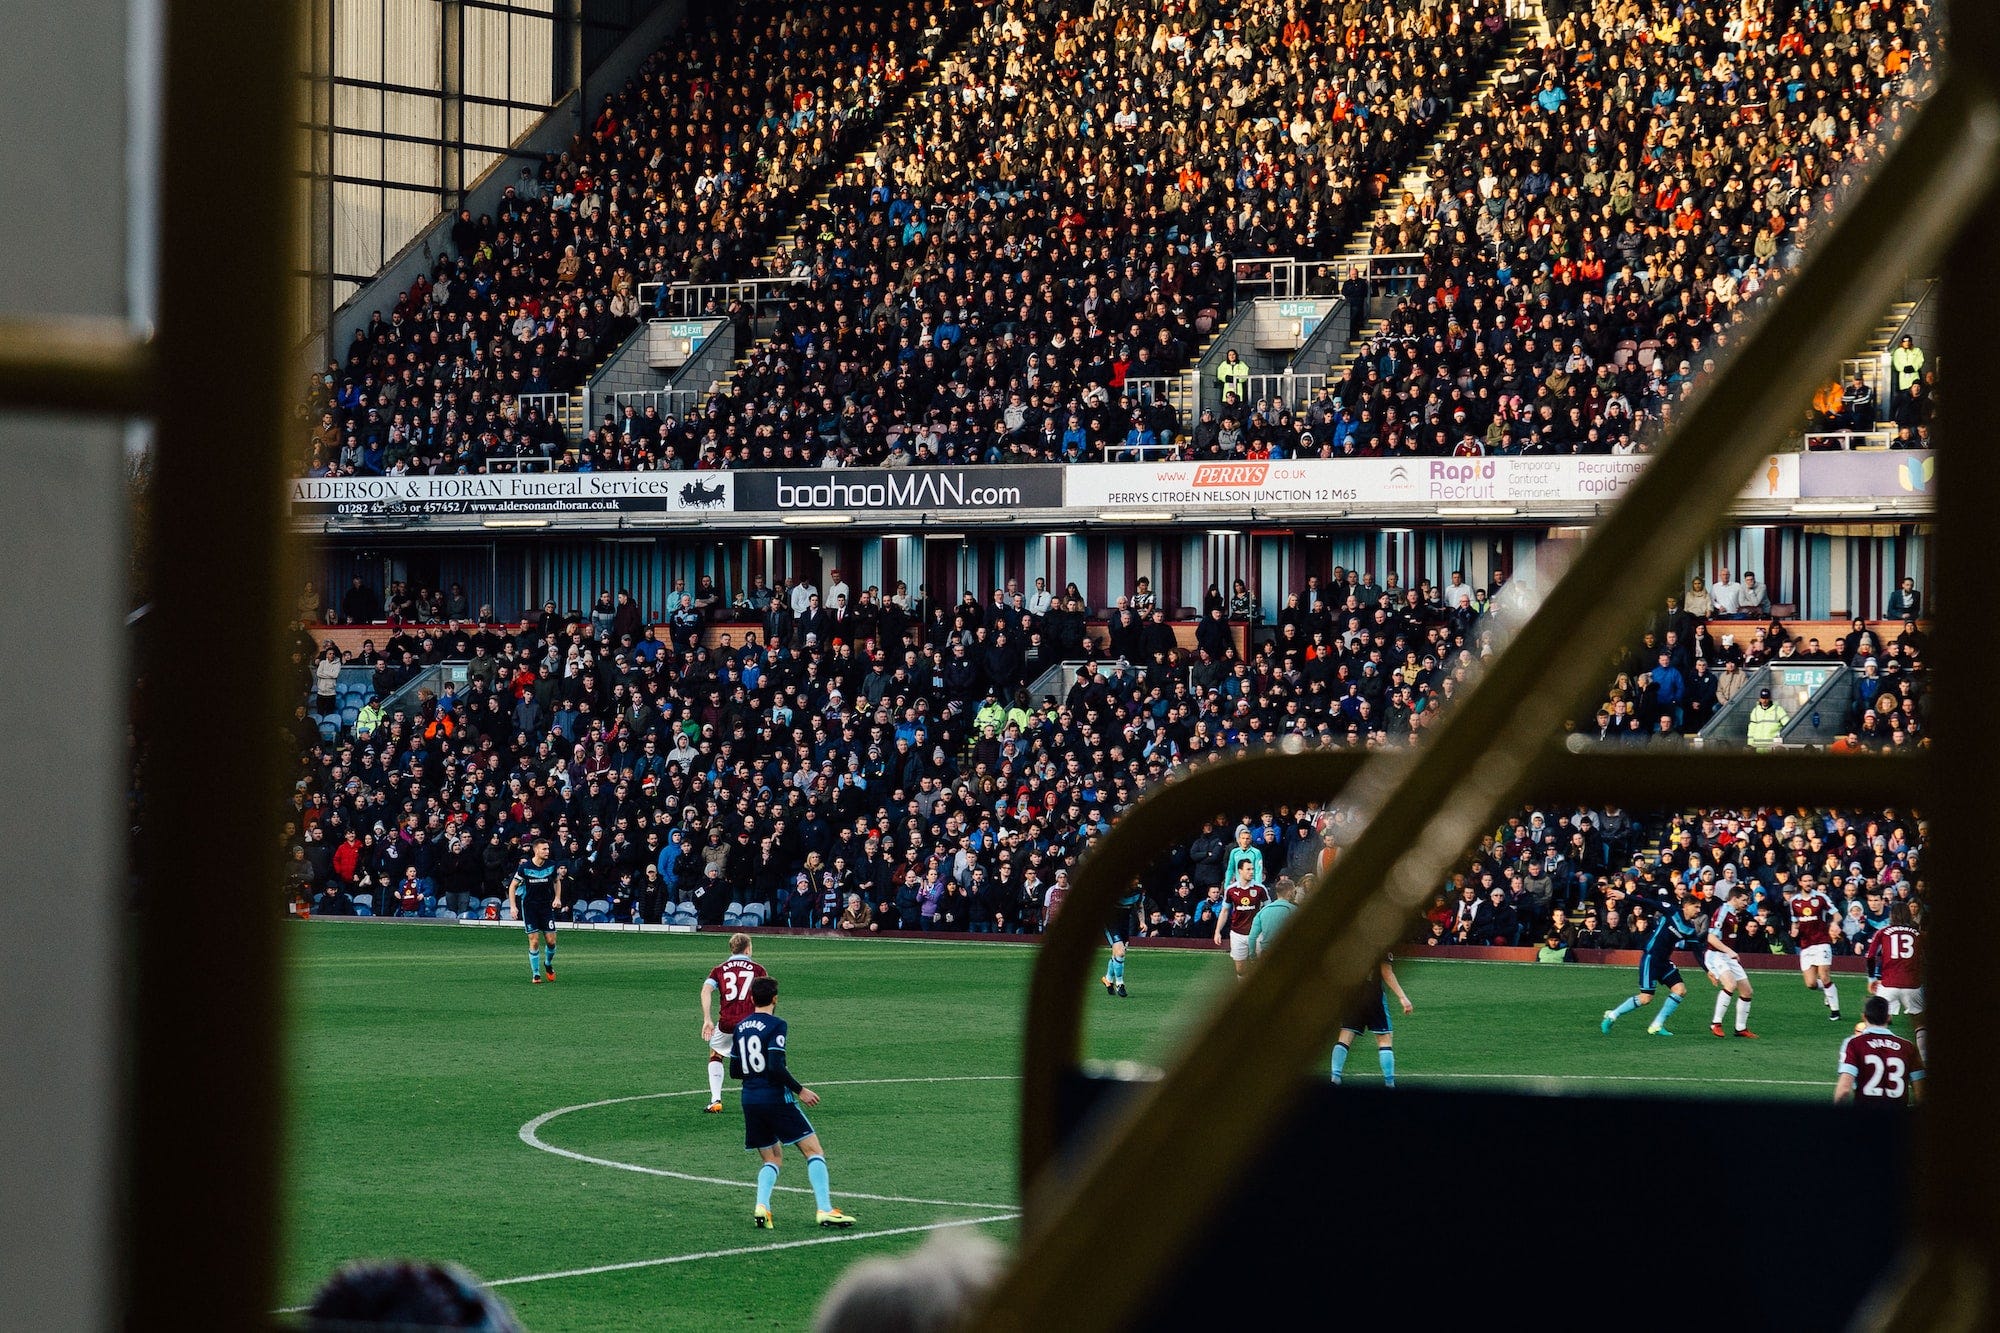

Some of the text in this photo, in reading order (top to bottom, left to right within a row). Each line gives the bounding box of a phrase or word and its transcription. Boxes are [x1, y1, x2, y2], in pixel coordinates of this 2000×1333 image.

[1297, 305, 1314, 314] EXIT
[688, 326, 702, 334] EXIT
[1508, 460, 1560, 472] Temporary
[1196, 465, 1265, 484] PERRYS
[1508, 473, 1548, 484] Contract
[293, 476, 668, 499] ALDERSON & HORAN Funeral Services
[777, 472, 1020, 507] boohooMAN.com
[1430, 482, 1495, 499] Recruit
[1508, 487, 1560, 498] Permanent
[1108, 492, 1149, 503] PERRYS
[1204, 490, 1250, 502] NELSON
[1253, 489, 1311, 503] JUNCTION
[1316, 489, 1328, 500] 12
[1332, 489, 1357, 500] M65
[337, 503, 368, 514] 01282
[410, 504, 421, 513] or
[423, 502, 459, 513] 457452
[471, 499, 620, 512] www.aldersonandhoran.co.uk
[548, 919, 555, 930] 6
[1890, 933, 1914, 959] 13
[722, 960, 753, 972] ARFIELD
[723, 970, 754, 1001] 37
[1866, 1038, 1902, 1050] WARD
[738, 1034, 766, 1074] 18
[1862, 1054, 1906, 1098] 23
